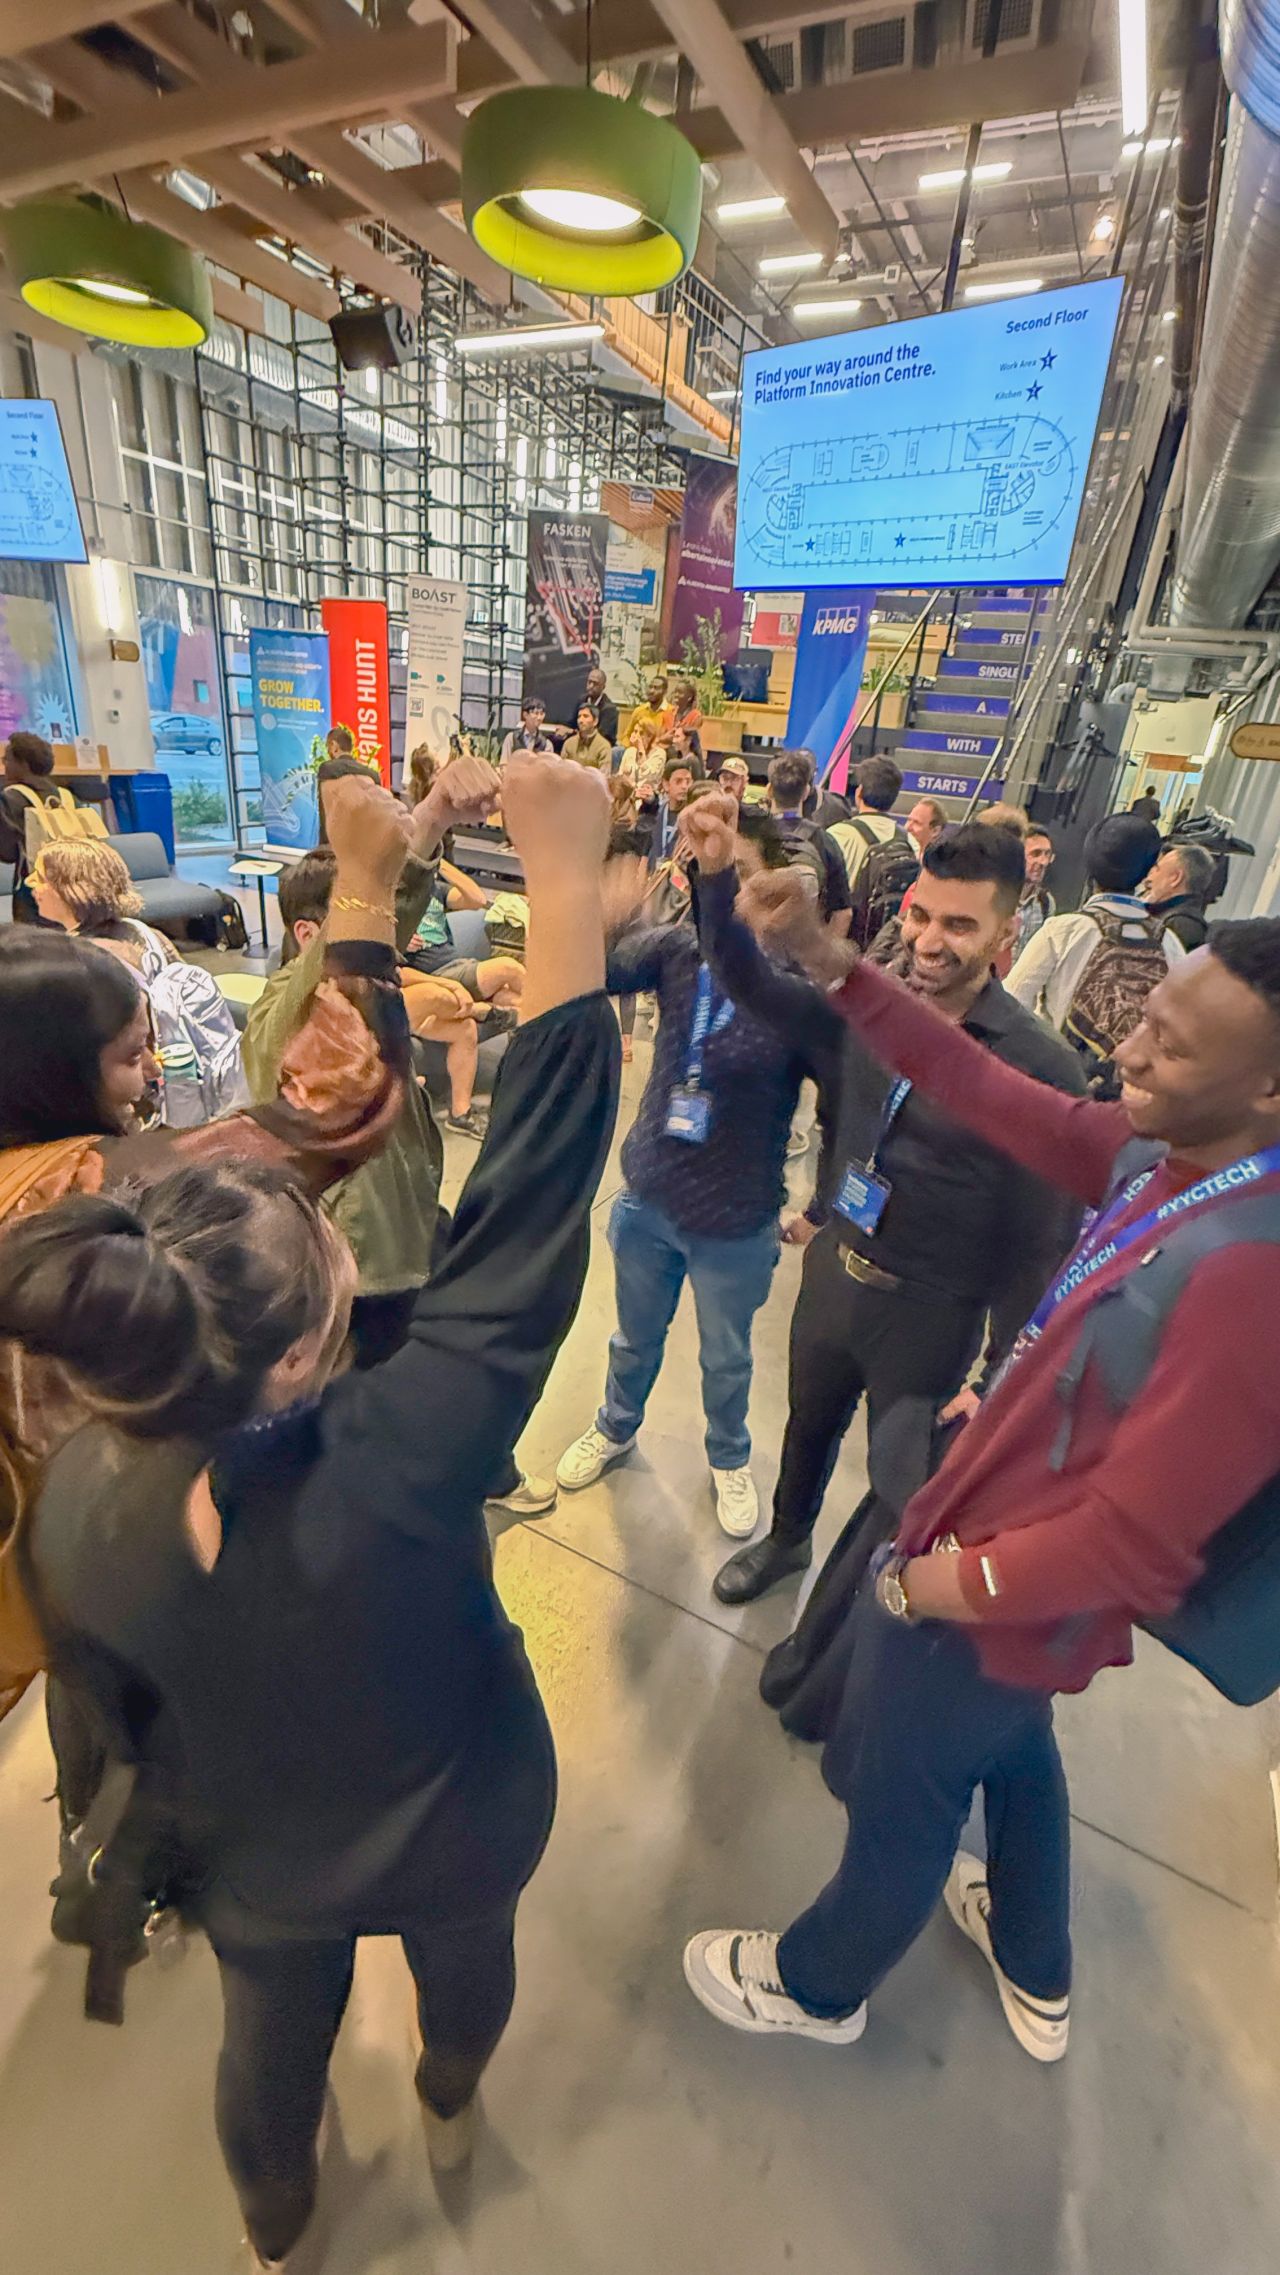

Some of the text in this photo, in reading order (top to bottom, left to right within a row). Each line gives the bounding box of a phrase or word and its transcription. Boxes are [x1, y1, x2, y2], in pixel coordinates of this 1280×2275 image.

[1006, 309, 1089, 334] Second Floor
[755, 343, 920, 387] Find your way around the
[754, 362, 937, 405] Platform Innovation Centre.
[543, 522, 592, 538] FASKEN
[812, 616, 858, 637] KPMG
[978, 665, 1019, 679] SINGLE
[258, 678, 294, 695] GROW
[259, 694, 325, 713] TOGETHER.
[975, 700, 987, 714] A
[947, 738, 981, 753] WITH
[917, 776, 968, 794] STARTS
[1156, 1154, 1260, 1221] #YYCTECH
[1053, 1242, 1117, 1303] #YYCTECH
